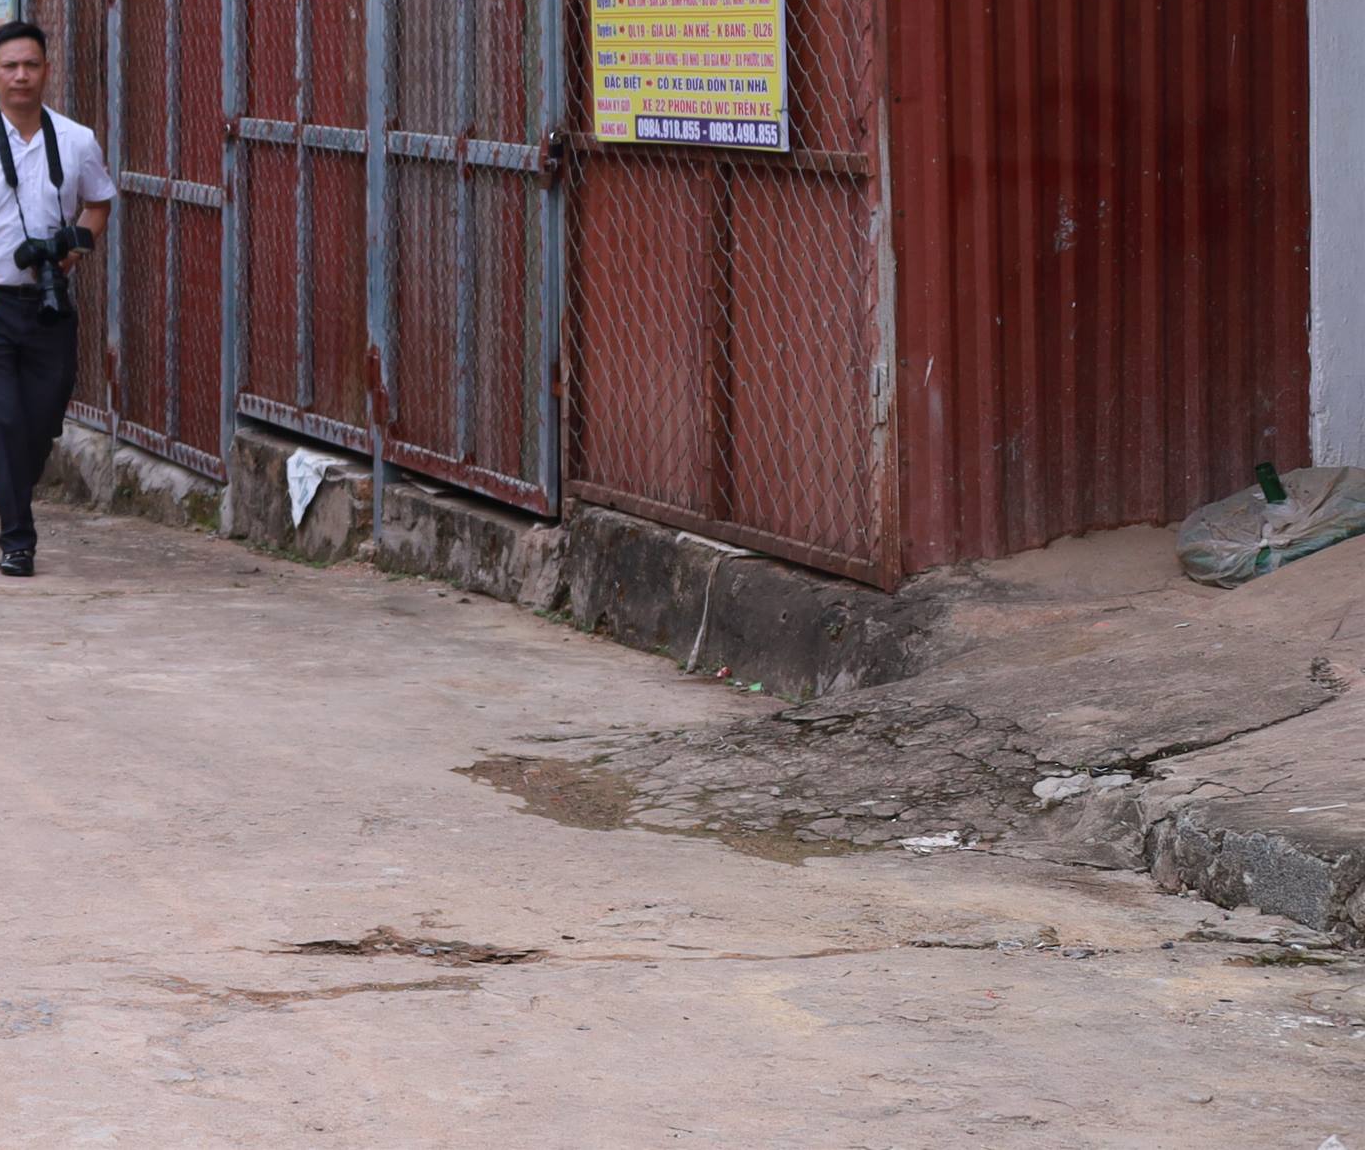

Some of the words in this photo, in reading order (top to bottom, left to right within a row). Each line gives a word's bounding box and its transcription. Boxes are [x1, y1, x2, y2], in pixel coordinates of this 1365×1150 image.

[628, 23, 645, 39] QL19
[651, 23, 664, 38] GIA
[665, 23, 677, 38] LAI
[683, 22, 694, 38] AN
[724, 22, 746, 38] BANG
[753, 22, 773, 38] QL26
[623, 75, 642, 93] BIỆT
[657, 76, 669, 90] CÓ
[672, 78, 684, 91] XE
[686, 77, 705, 91] ĐƯA
[707, 76, 726, 92] ĐÓN
[729, 78, 745, 95] TẠI
[747, 76, 768, 93] NHÀ
[642, 98, 653, 112] XE
[655, 99, 666, 113] 22
[668, 98, 698, 115] PHÒNG
[700, 99, 713, 115] CÓ
[715, 102, 730, 116] WC
[732, 100, 757, 116] TRÊN
[759, 102, 771, 117] XE
[637, 118, 700, 141] 0984.918.855
[709, 121, 778, 146] 0983.498.855
